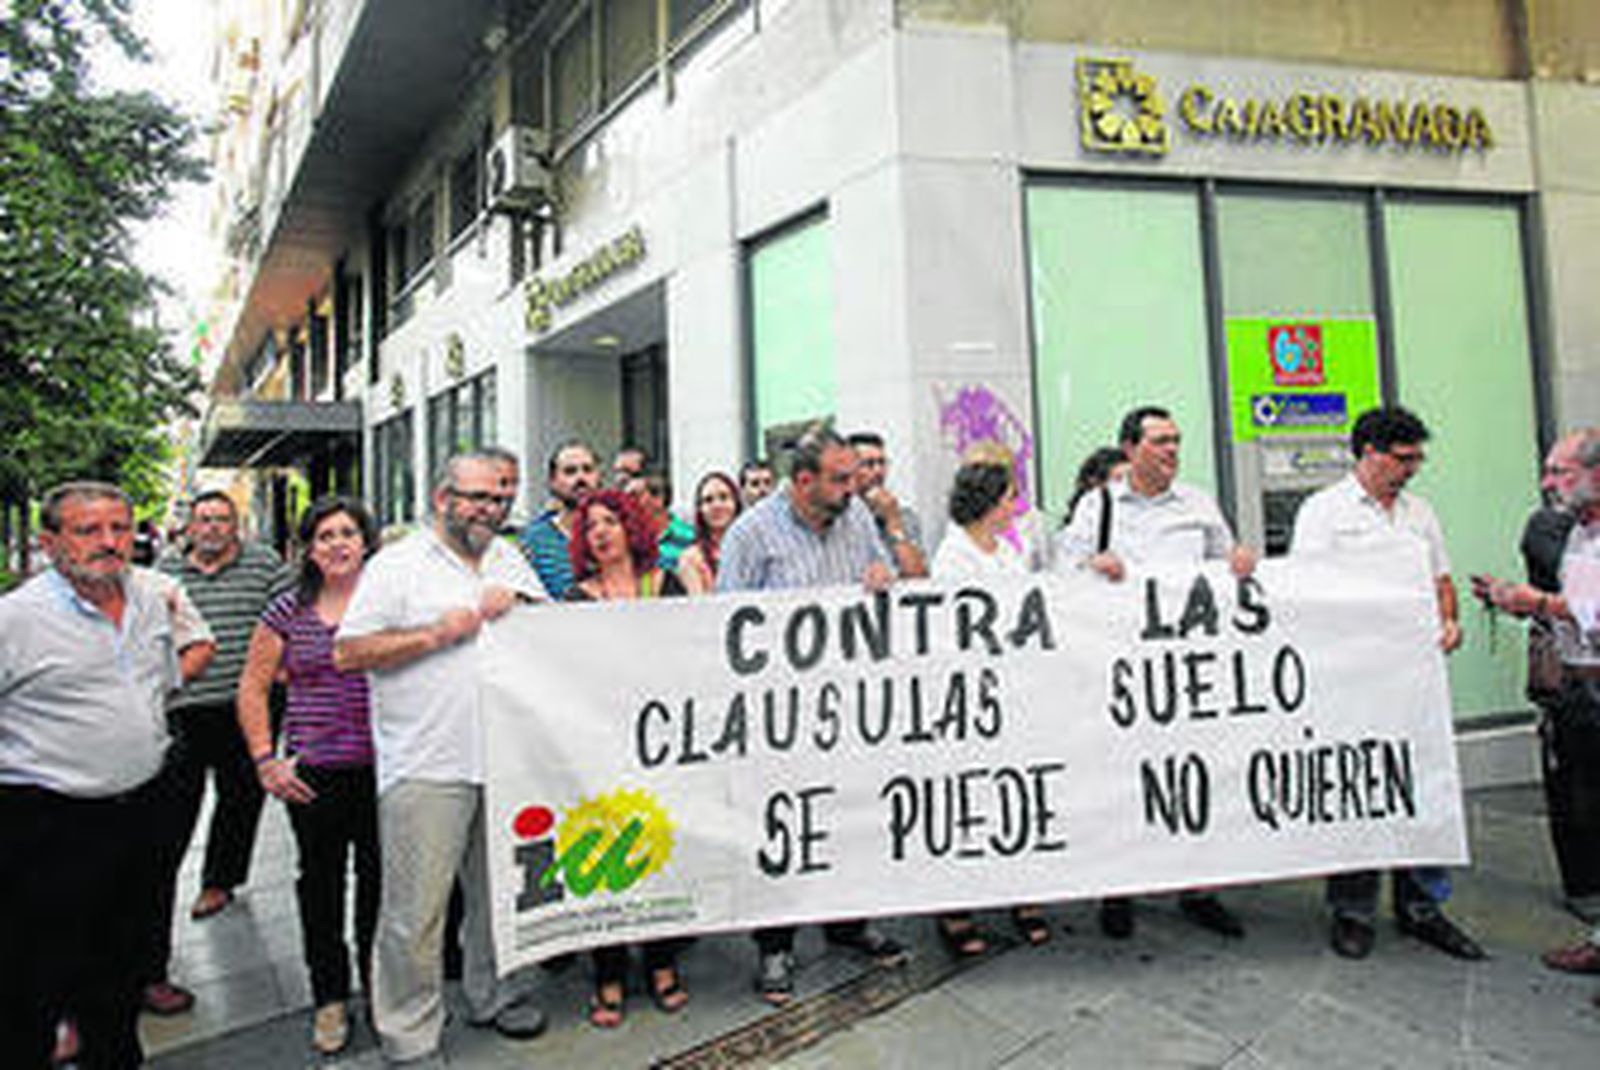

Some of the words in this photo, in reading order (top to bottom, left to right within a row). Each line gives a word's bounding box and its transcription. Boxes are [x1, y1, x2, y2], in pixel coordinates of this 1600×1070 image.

[725, 588, 1055, 675] CONTRA
[1141, 574, 1271, 639] LAS
[635, 670, 1001, 768] CLAUSULAS
[1110, 645, 1306, 727] SUELO
[758, 786, 835, 876] SE
[881, 763, 1066, 860] PUEDE
[1140, 753, 1210, 834] NO
